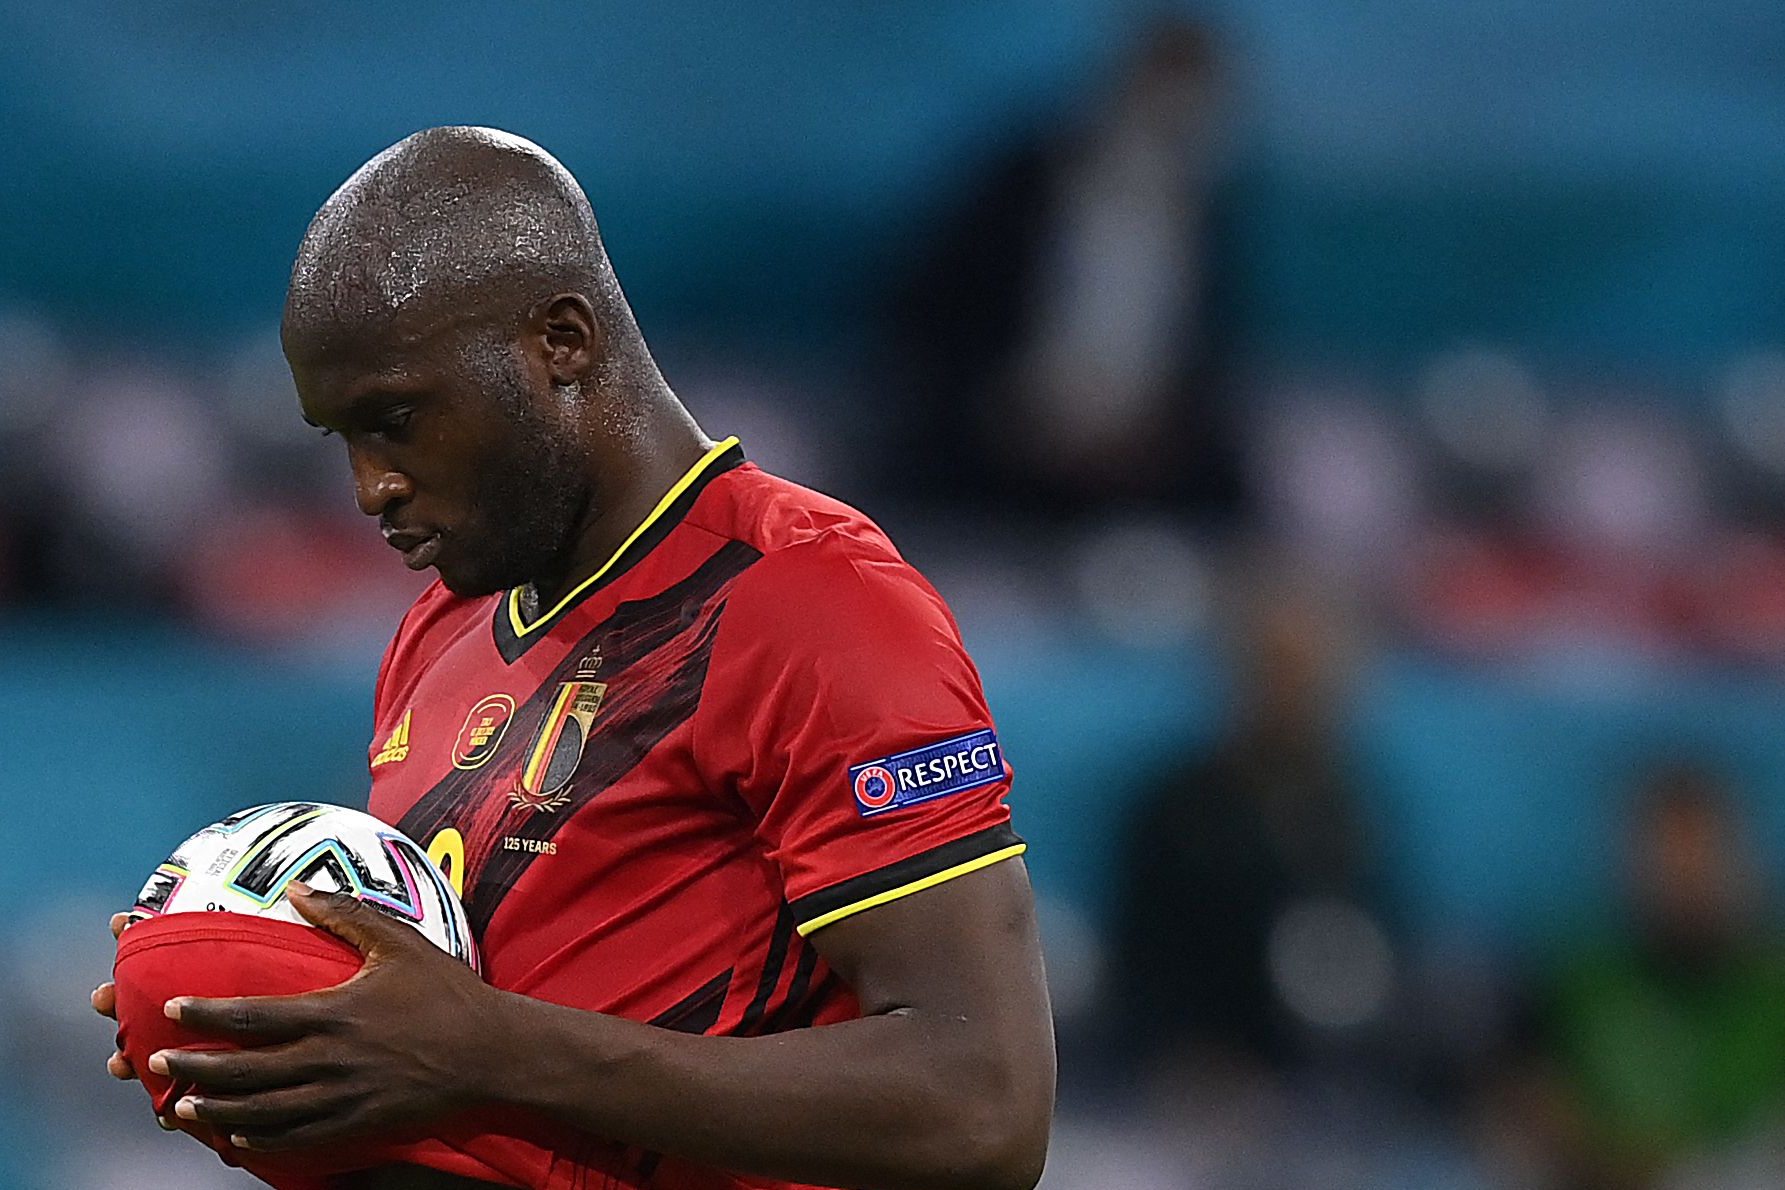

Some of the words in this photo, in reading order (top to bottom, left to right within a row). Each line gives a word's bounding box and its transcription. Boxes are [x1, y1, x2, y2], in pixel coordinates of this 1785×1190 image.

[898, 743, 997, 791] RESPECT
[504, 837, 520, 851] 125
[522, 839, 557, 855] YEARS
